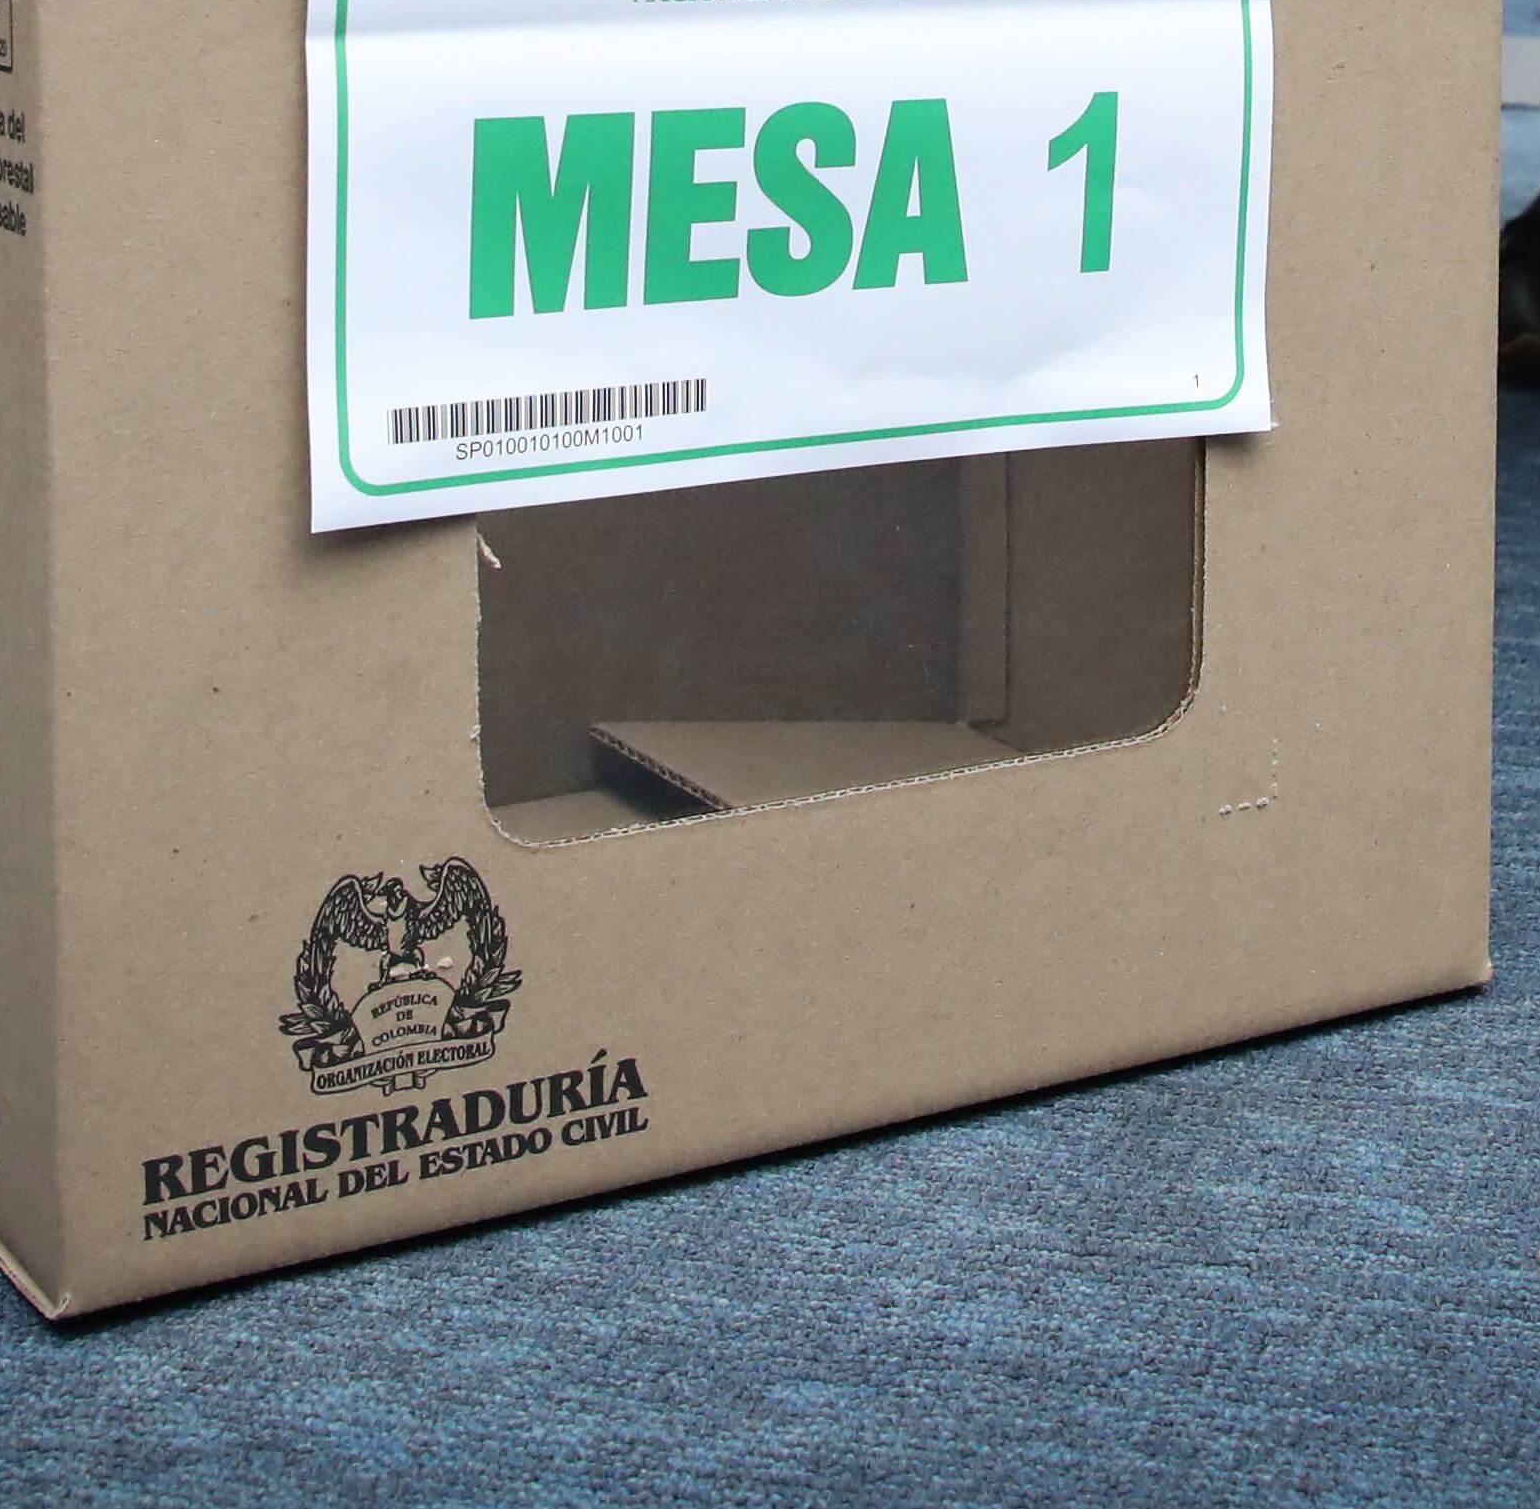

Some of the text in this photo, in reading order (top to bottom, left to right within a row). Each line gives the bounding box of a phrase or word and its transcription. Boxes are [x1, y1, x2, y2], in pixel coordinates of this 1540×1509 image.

[8, 108, 26, 143] del
[469, 91, 1119, 320] MESA 1
[455, 423, 644, 461] SP010010100M1001
[370, 993, 439, 1020] REPÚBLICA
[395, 1009, 414, 1022] DE
[371, 1023, 438, 1047] COLOMBIA
[316, 1041, 492, 1090] ORGANIZACIÓN ELECTORAL
[141, 1048, 649, 1206] REGISTRADURÍA
[142, 1107, 649, 1242] NACIONAL DEL ESTADO CIVIL
